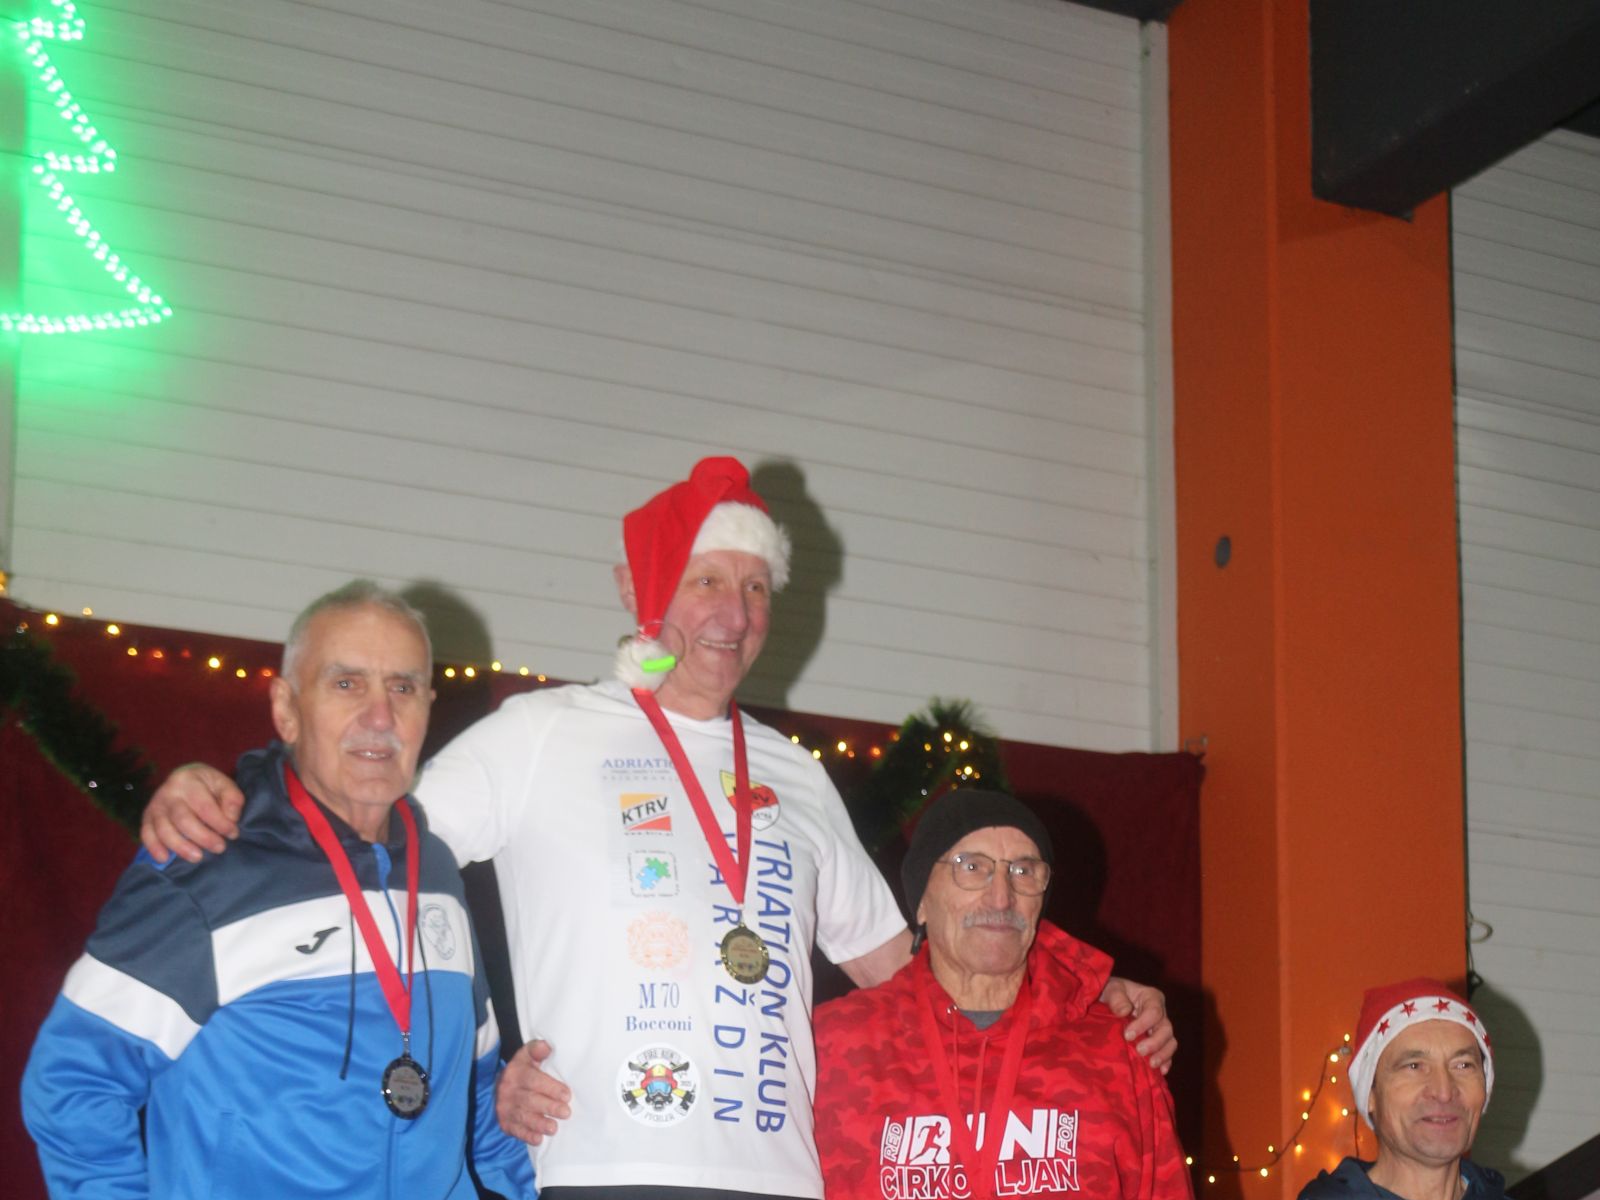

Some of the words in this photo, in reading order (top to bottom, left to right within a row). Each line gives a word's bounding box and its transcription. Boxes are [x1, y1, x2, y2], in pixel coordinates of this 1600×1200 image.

[622, 797, 668, 825] KTRV
[639, 983, 656, 1009] M
[661, 983, 680, 1009] 70
[626, 1015, 692, 1031] Bocconi
[756, 1032, 789, 1133] KLUB
[884, 1122, 904, 1162] RED
[1057, 1113, 1076, 1154] FOR
[880, 1158, 1080, 1200] CIRKOLJAN
